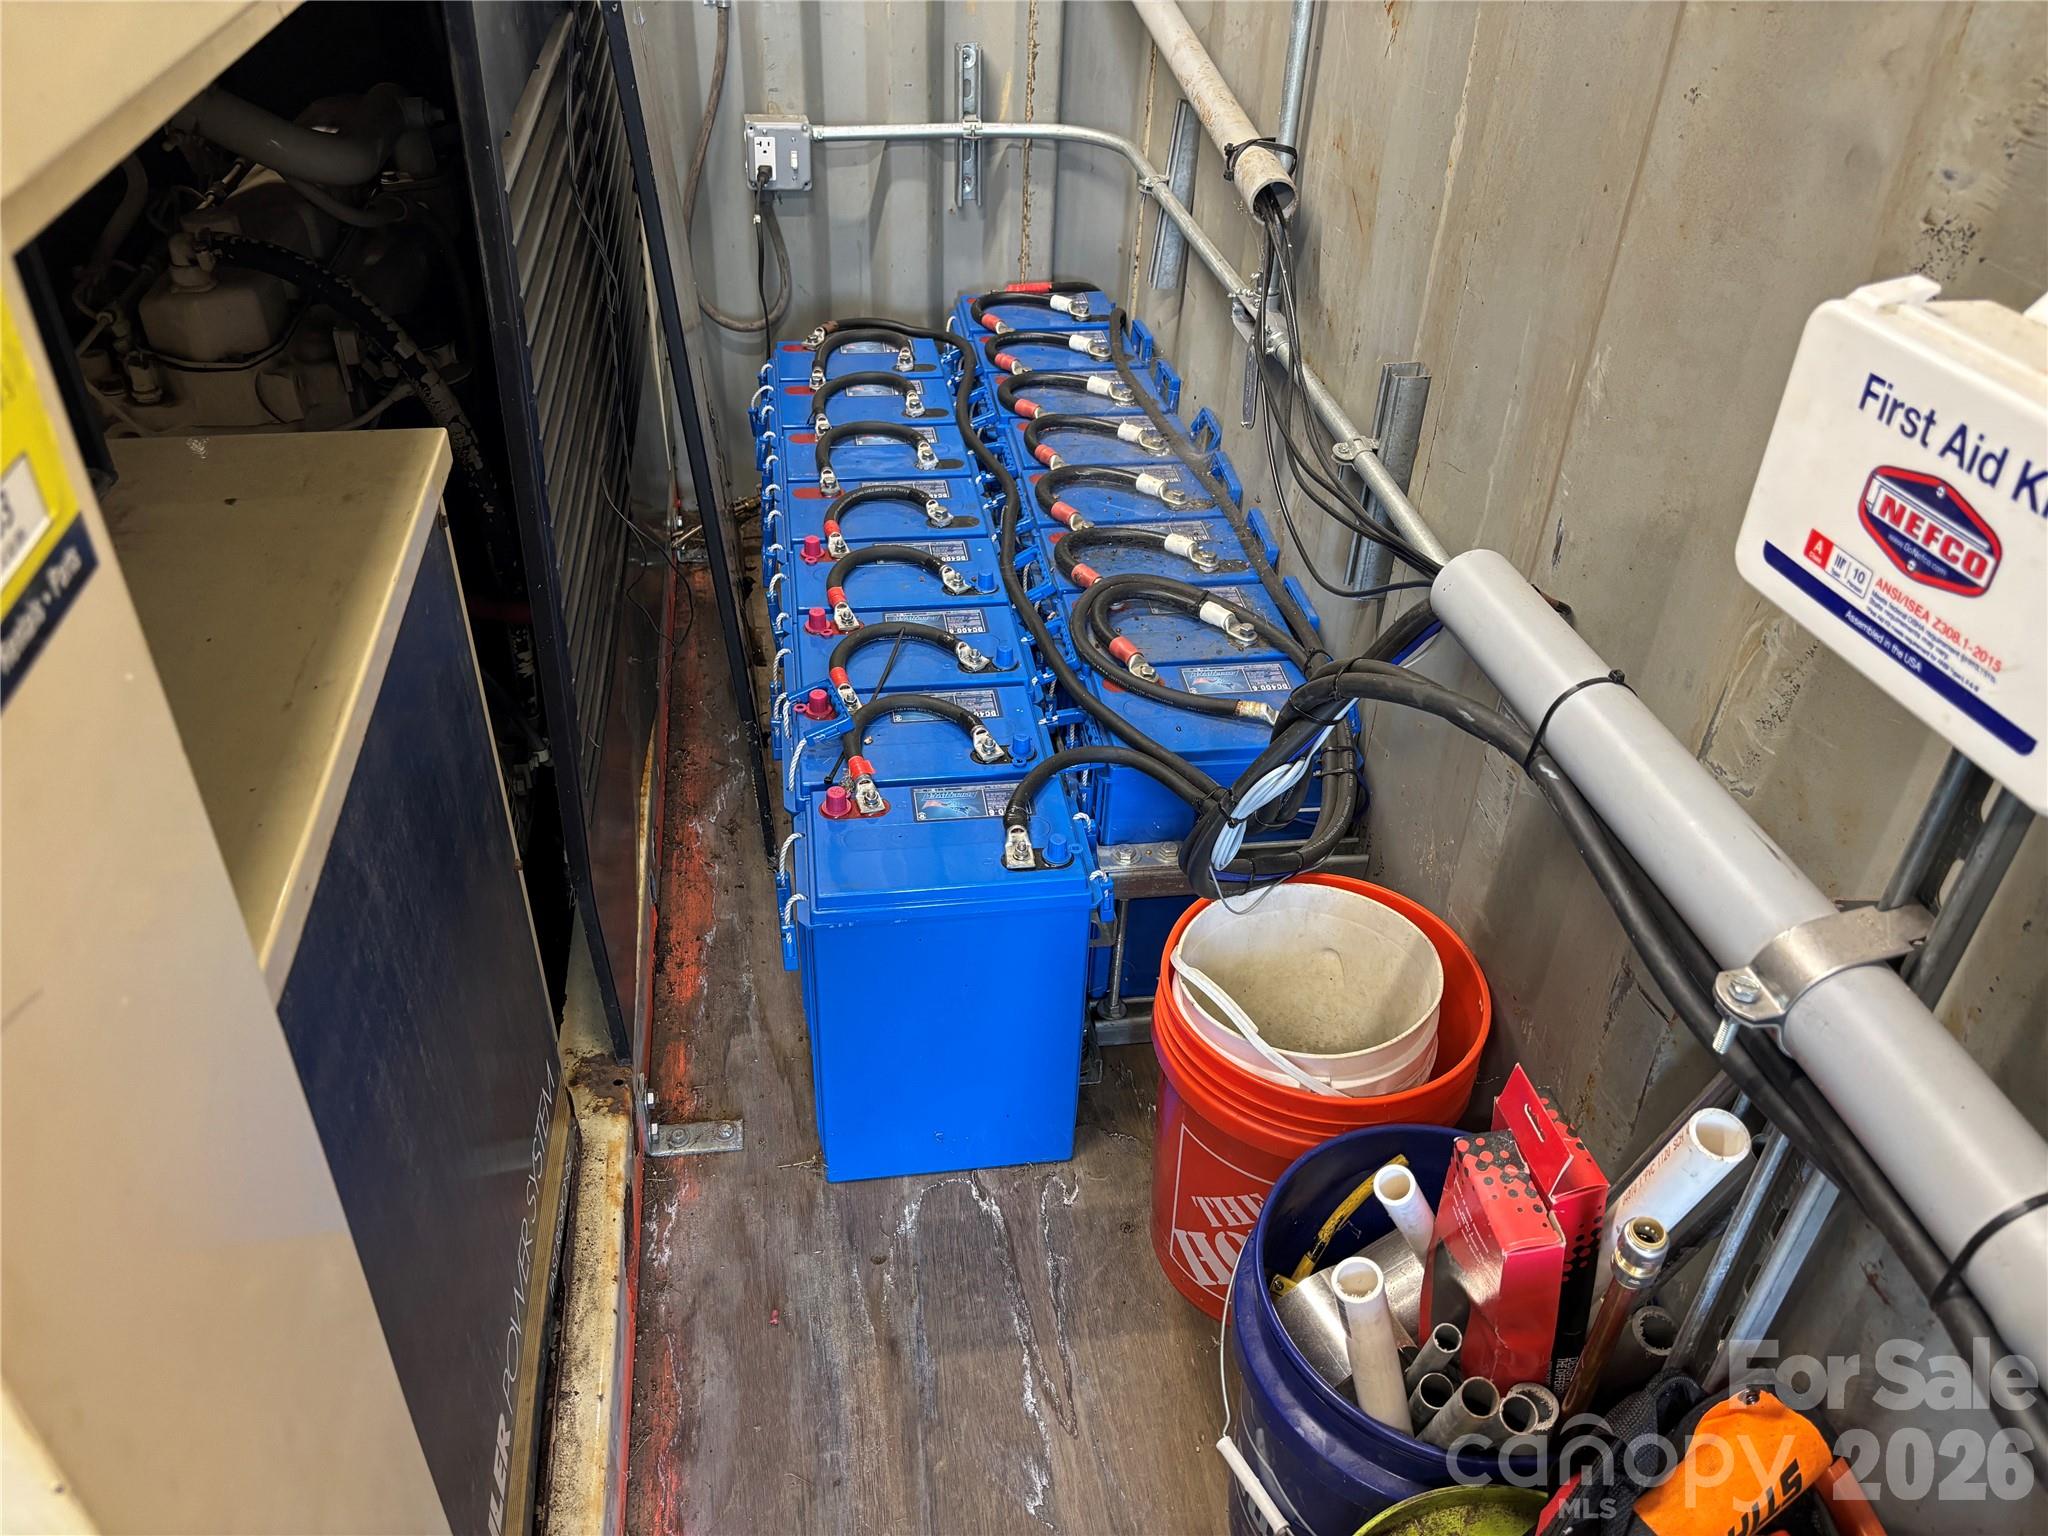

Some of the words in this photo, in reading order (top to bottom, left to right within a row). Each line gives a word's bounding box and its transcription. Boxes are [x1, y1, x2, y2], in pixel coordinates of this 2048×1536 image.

[1859, 372, 1937, 449] First
[1938, 423, 2010, 489] Aid
[2011, 459, 2048, 519] K
[1812, 539, 1824, 555] A
[1878, 493, 1989, 580] NEFCO
[1853, 568, 1866, 585] 10
[1844, 610, 1884, 644] Assembled
[1883, 637, 1892, 649] in
[1891, 643, 1904, 661] the
[1903, 651, 1923, 674] USA
[1875, 577, 1930, 623] ANSI/ISEA
[1931, 615, 2002, 673] Z308.1-2015
[501, 1217, 534, 1415] POWER
[526, 1058, 556, 1224] SYSTEM
[1173, 1228, 1250, 1286] HO
